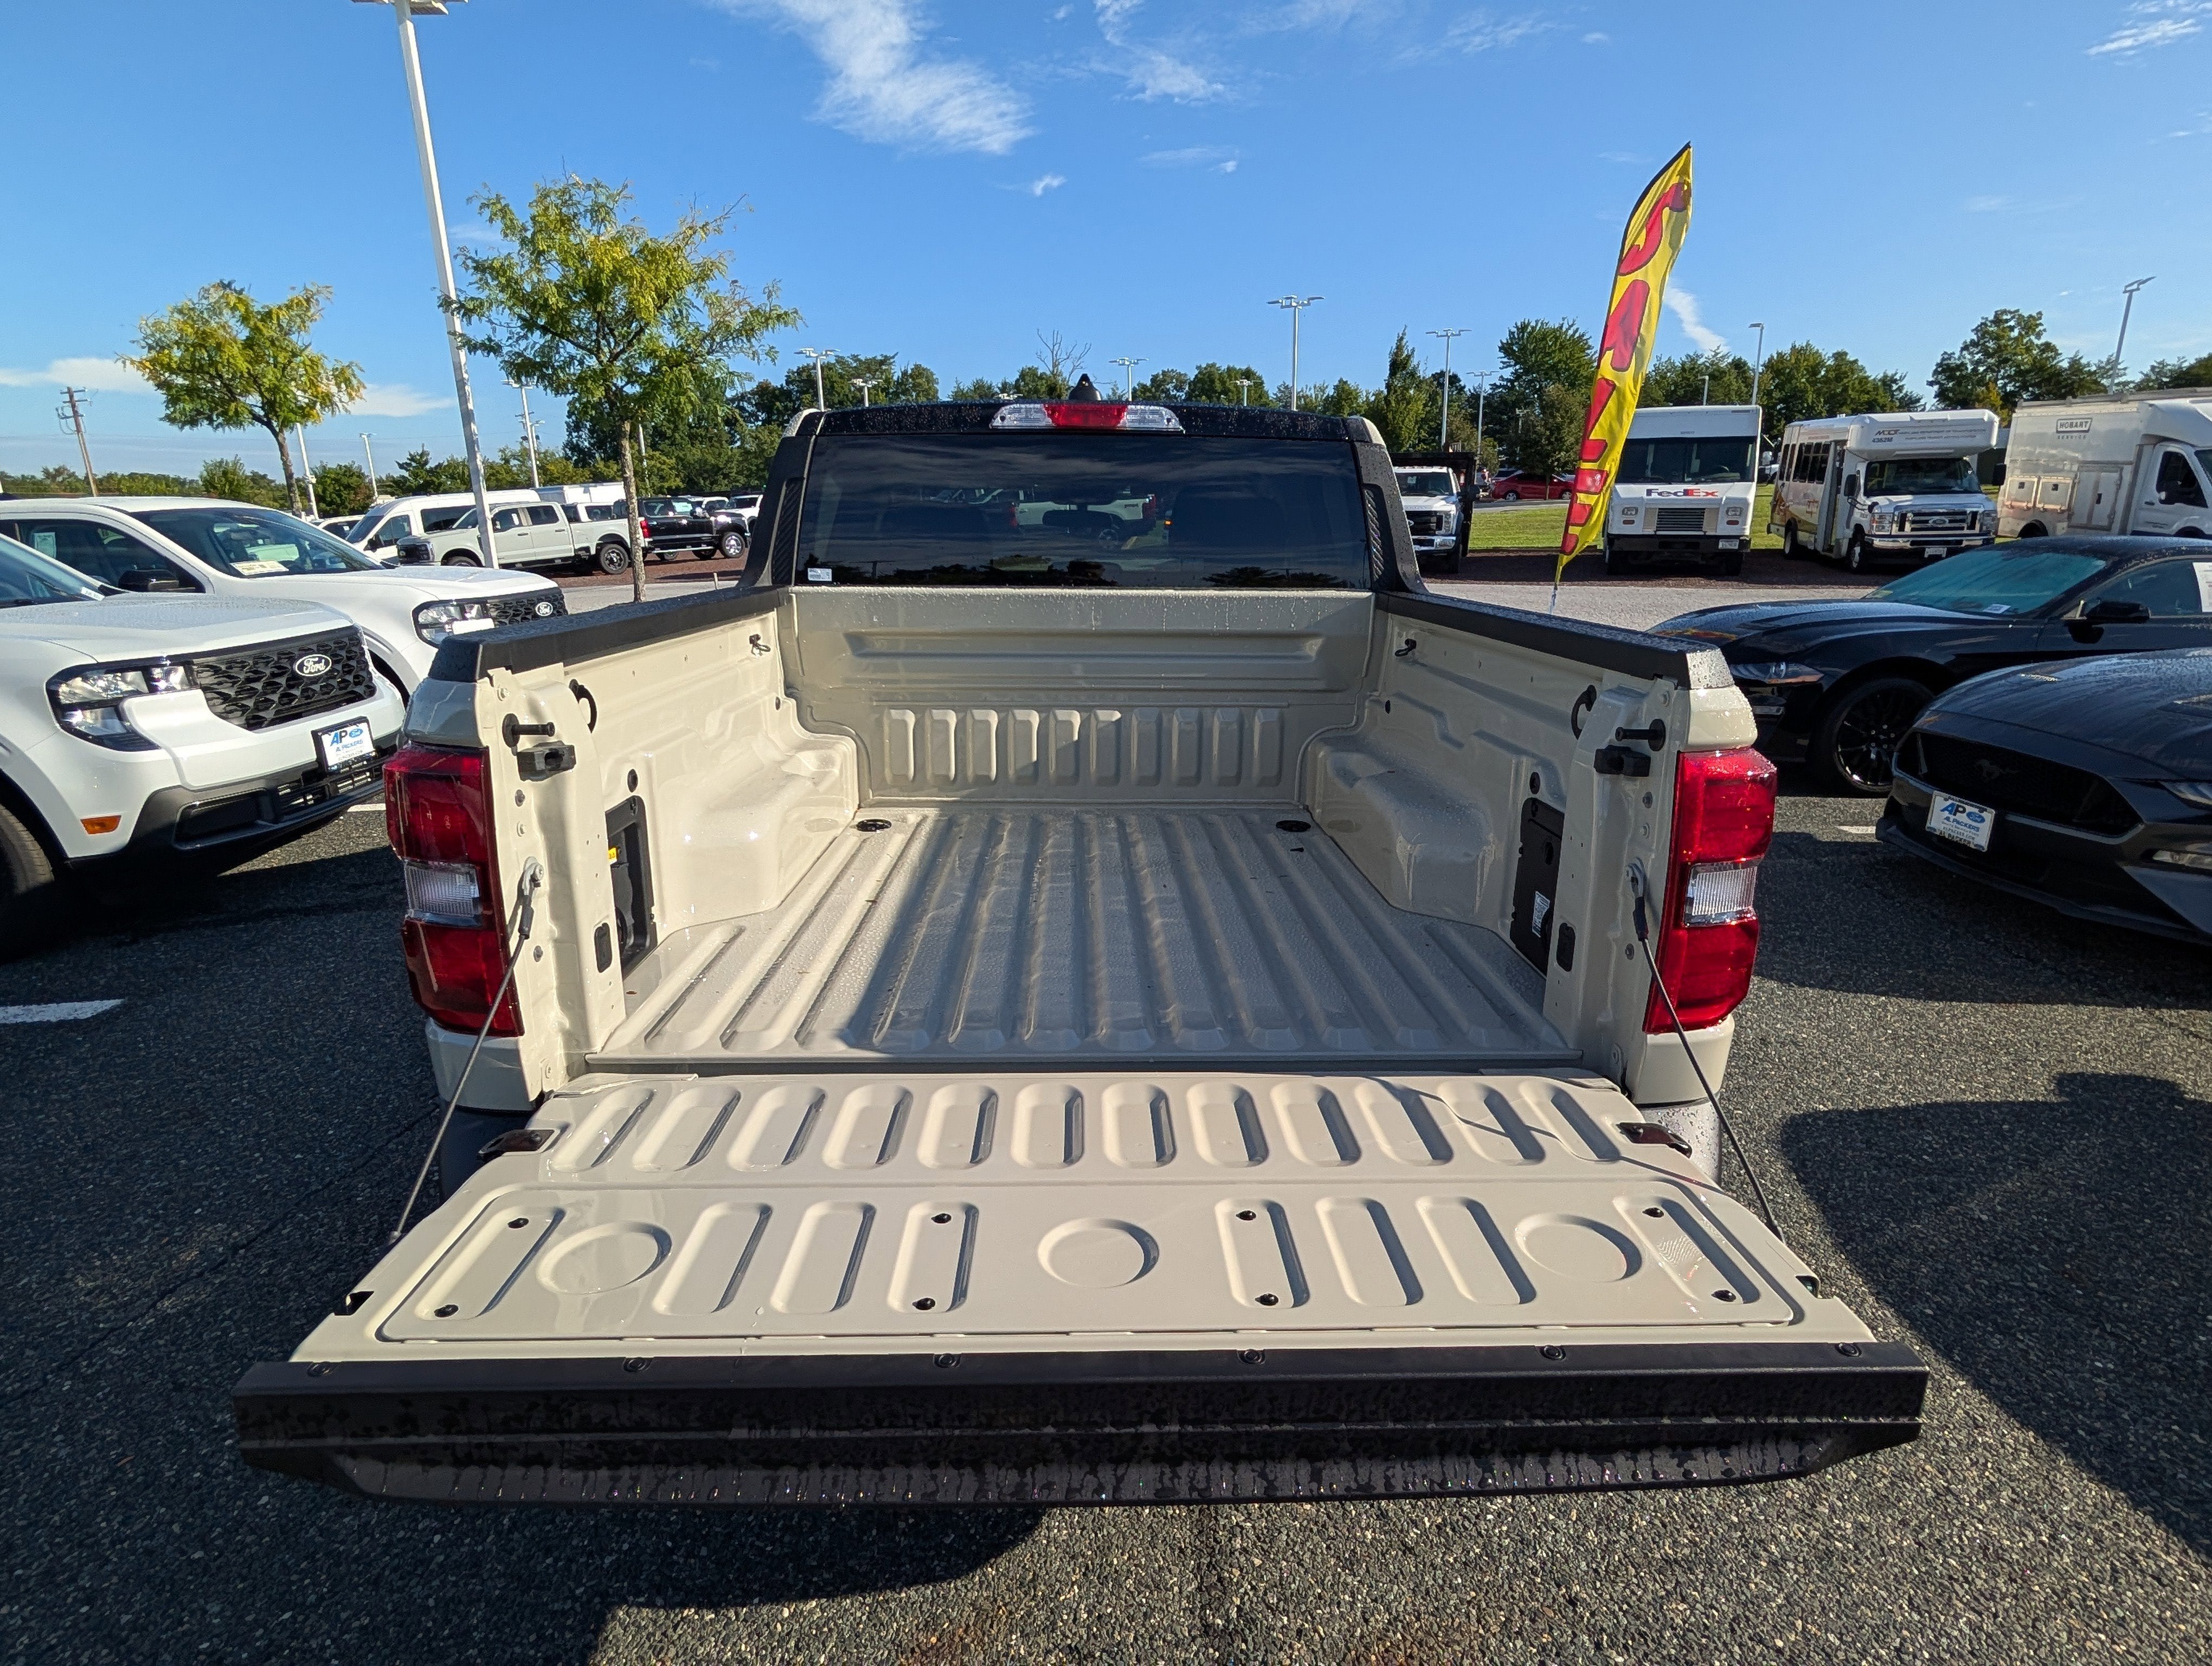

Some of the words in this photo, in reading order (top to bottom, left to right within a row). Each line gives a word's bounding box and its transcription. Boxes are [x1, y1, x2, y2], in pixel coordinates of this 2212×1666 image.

[2059, 420, 2089, 428] HOBART
[1646, 488, 1718, 497] FedEx
[303, 657, 326, 673] Ford
[330, 730, 348, 747] AP
[1940, 802, 1966, 816] AP
